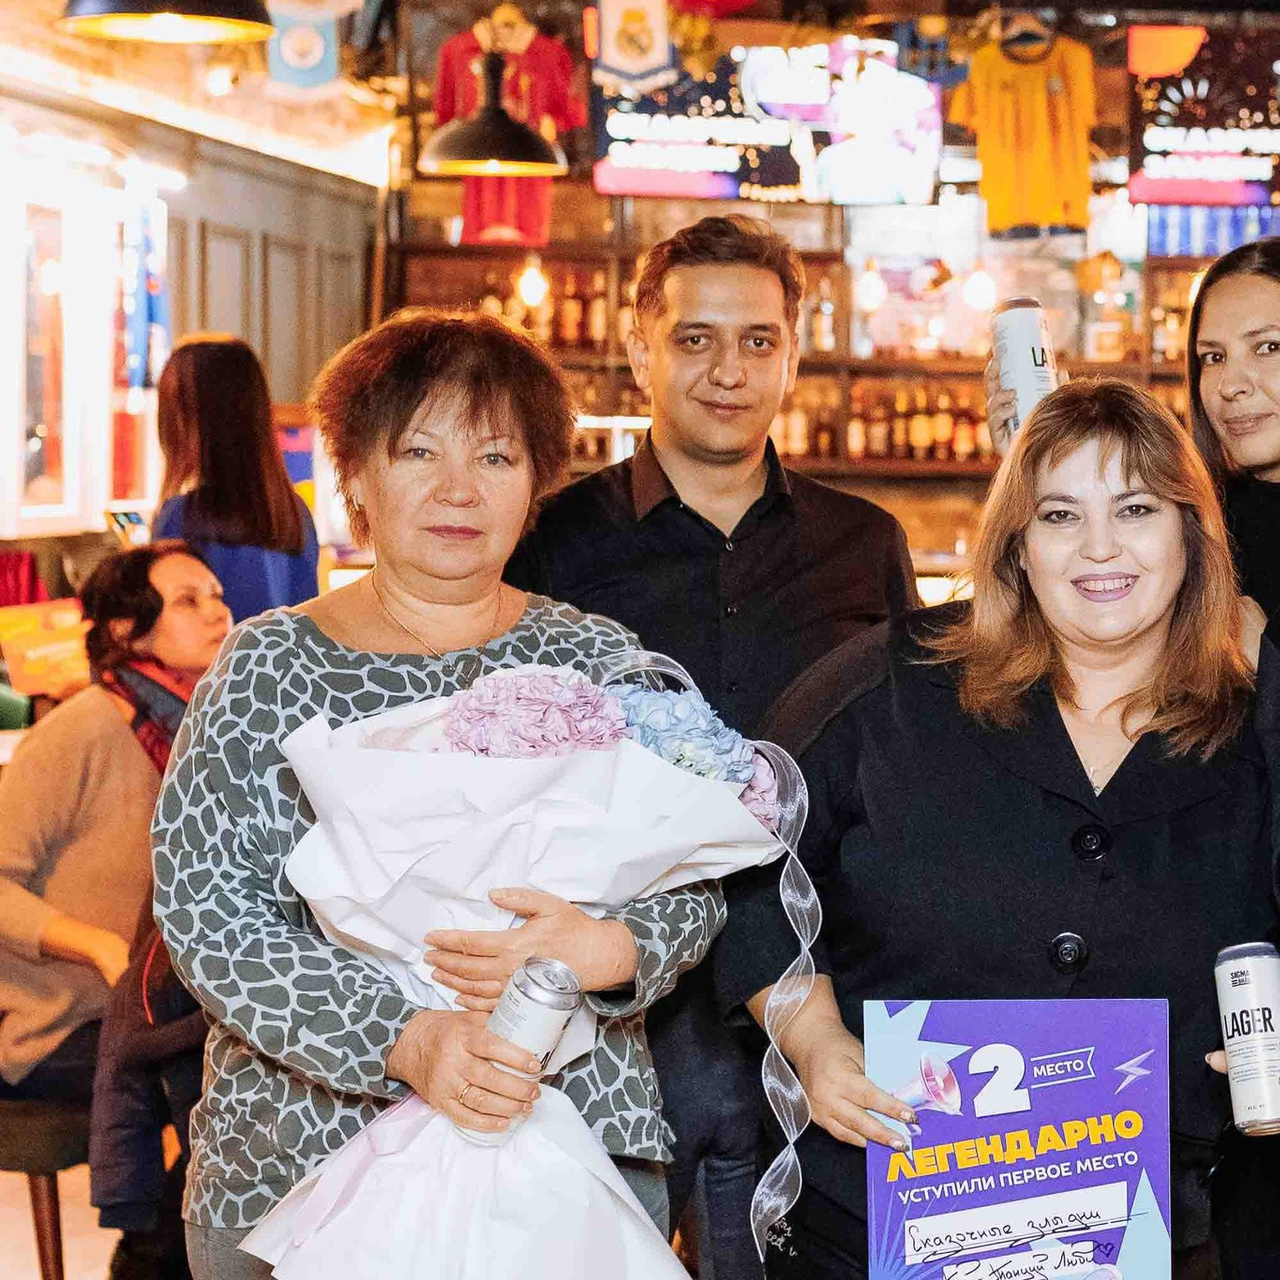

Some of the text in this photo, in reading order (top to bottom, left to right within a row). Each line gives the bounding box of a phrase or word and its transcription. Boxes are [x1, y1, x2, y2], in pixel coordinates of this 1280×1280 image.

[1223, 1006, 1275, 1040] LAGER
[968, 1043, 1084, 1118] 2 МЕСТО
[886, 1110, 1144, 1183] ЛЕГЕНДАРНО
[897, 1151, 1139, 1205] УСТУПИЛИ ПЕРВОЕ МЕСТО
